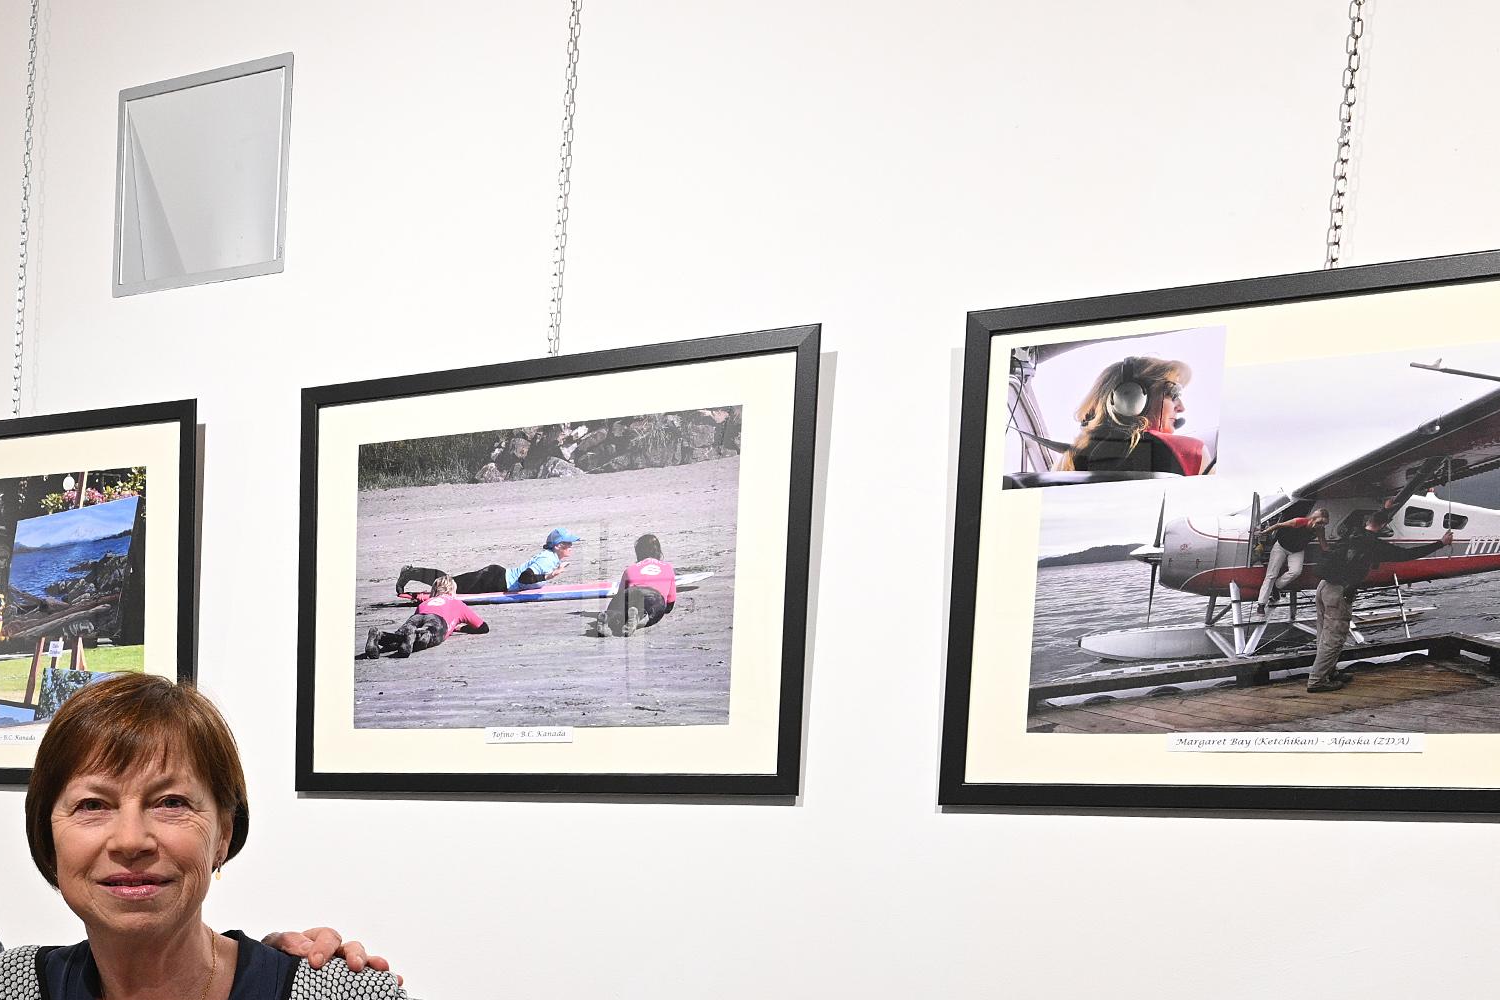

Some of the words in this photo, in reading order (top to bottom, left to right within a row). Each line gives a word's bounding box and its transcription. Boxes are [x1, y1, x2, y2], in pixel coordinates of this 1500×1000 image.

[537, 730, 566, 738] Kanada
[1176, 738, 1227, 748] Margaret
[1229, 738, 1252, 747] Bay
[1254, 736, 1319, 746] (Ketchikan)
[1327, 736, 1370, 748] Aljaska
[1374, 736, 1410, 746] (ZDA)
